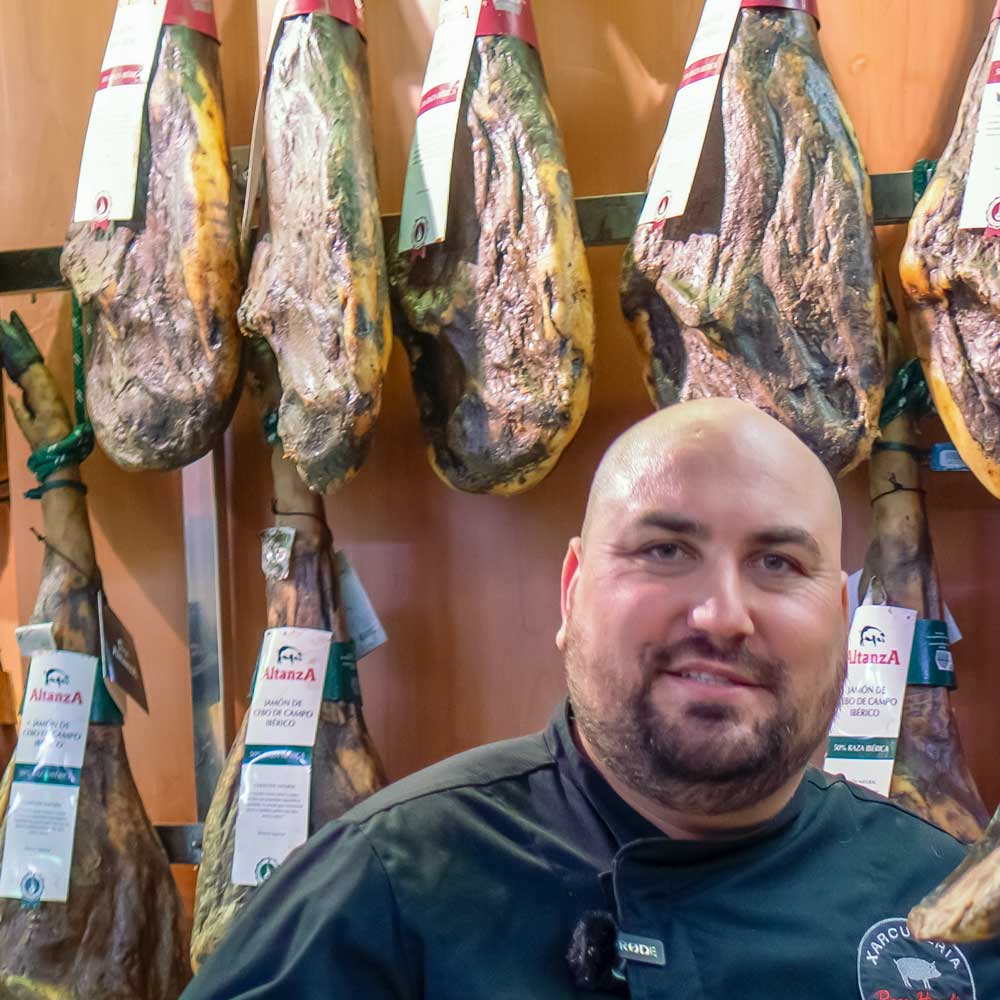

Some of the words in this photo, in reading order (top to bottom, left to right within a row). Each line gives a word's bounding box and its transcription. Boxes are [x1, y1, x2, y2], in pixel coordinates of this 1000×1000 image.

[875, 686, 887, 695] DE
[856, 697, 867, 706] DE
[868, 697, 898, 707] CAMPO
[849, 707, 881, 718] IBÉRICO
[847, 743, 865, 753] RAZA
[865, 924, 961, 970] XARCURIA
